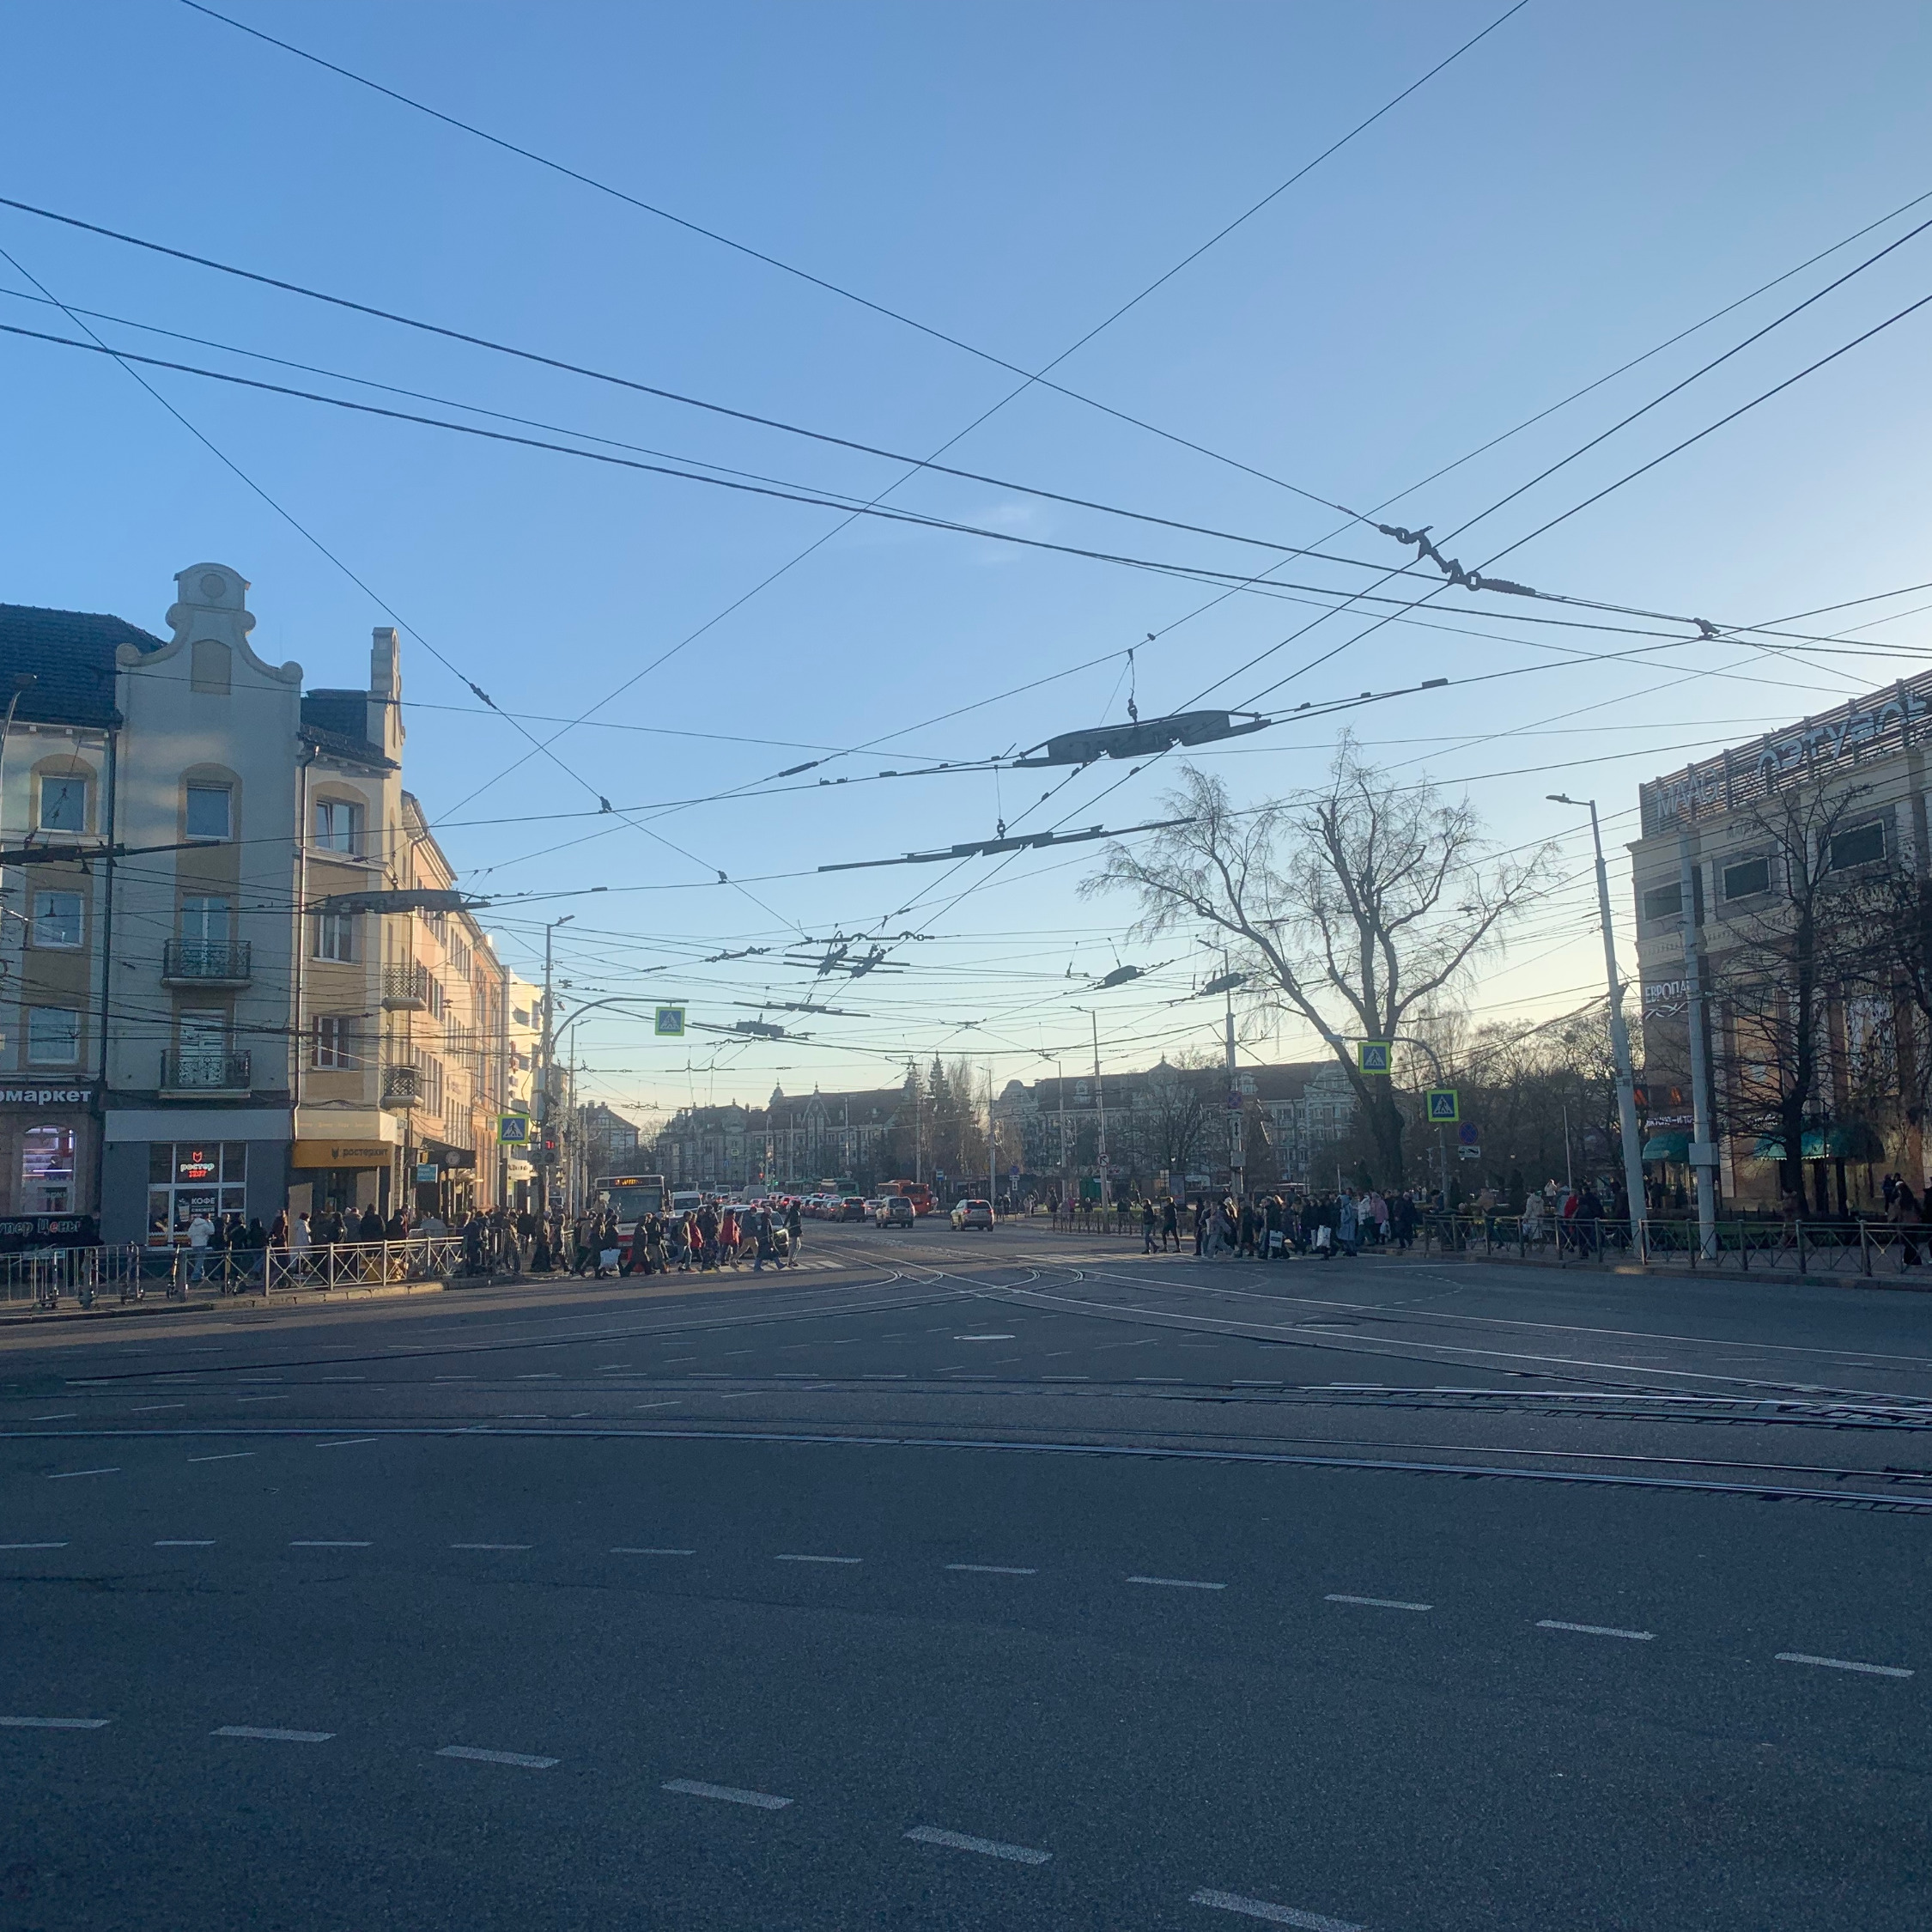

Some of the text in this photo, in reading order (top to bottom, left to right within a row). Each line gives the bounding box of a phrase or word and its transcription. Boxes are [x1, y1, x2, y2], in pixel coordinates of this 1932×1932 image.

[1657, 768, 1718, 817] MAAG
[1644, 980, 1687, 1004] ЕВРОПА
[37, 1218, 82, 1236] Цены
